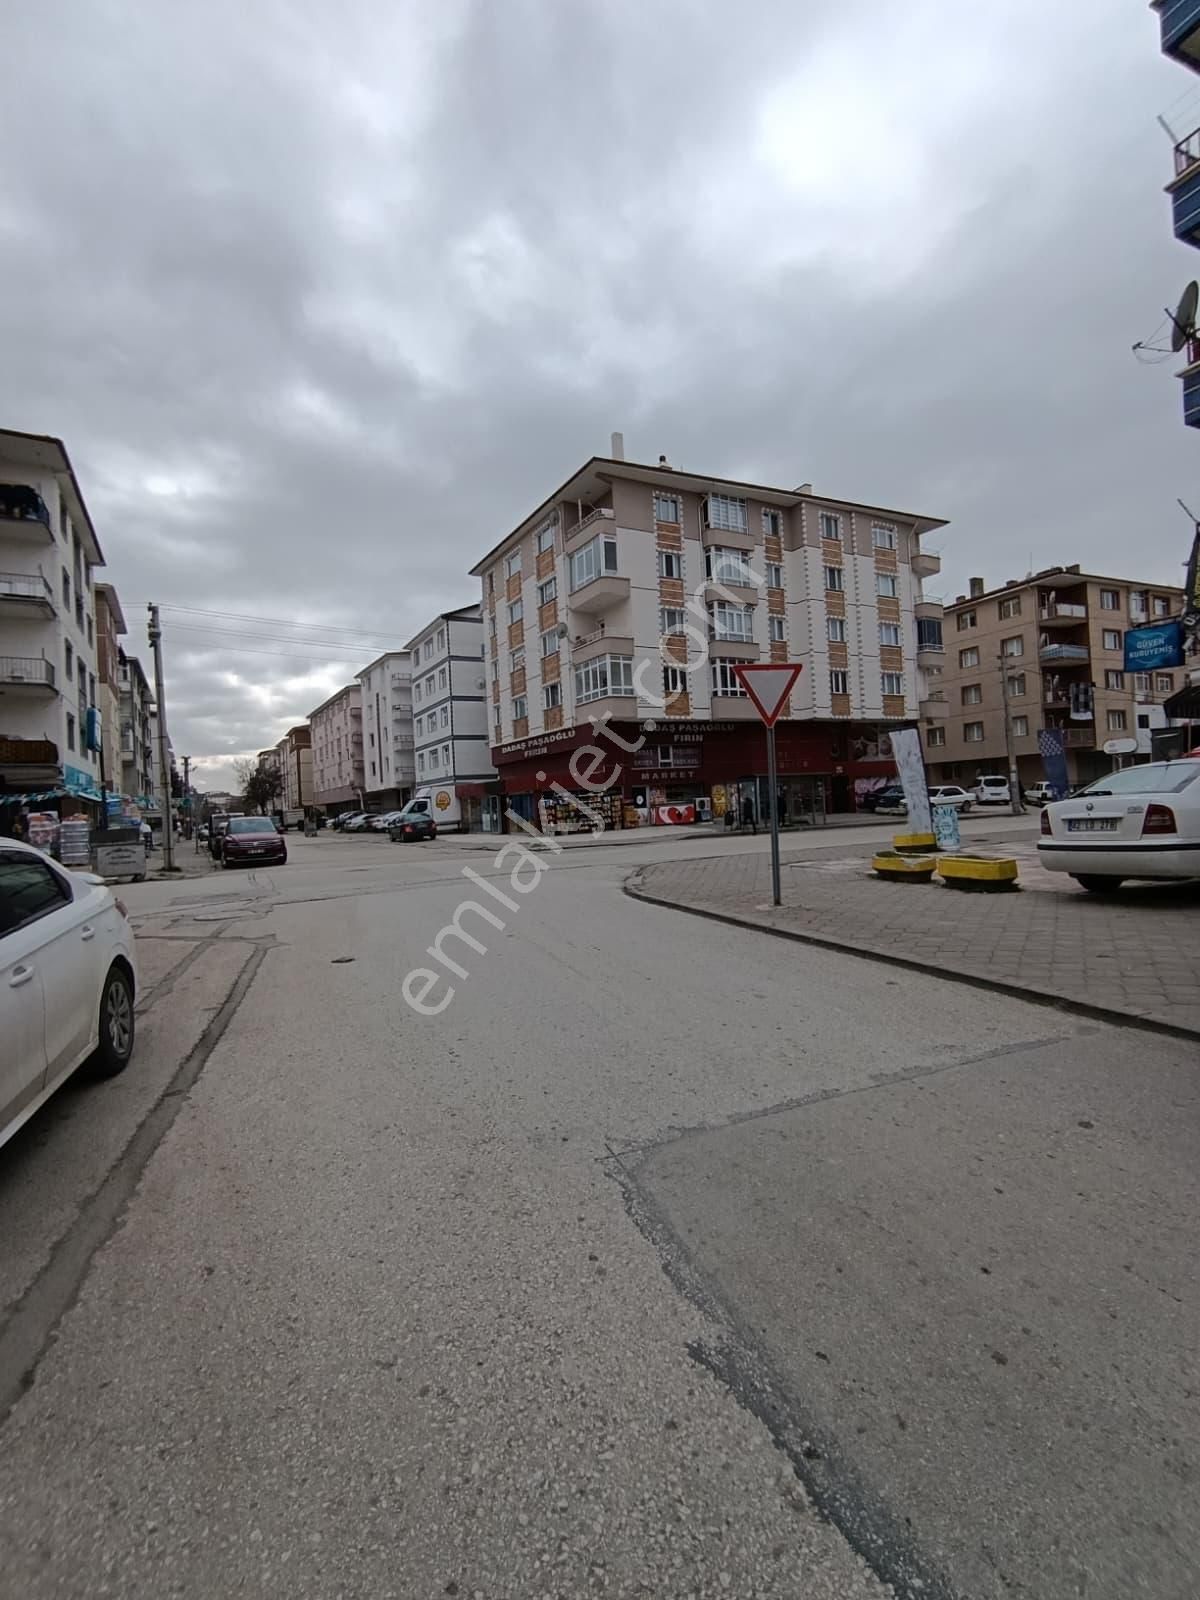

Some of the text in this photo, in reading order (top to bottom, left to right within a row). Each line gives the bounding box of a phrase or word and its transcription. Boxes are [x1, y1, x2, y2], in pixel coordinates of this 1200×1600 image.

[1136, 637, 1165, 649] GÜVEN
[639, 723, 676, 733] DDAŞ
[673, 734, 704, 742] FIRIN
[641, 770, 695, 780] MARKET
